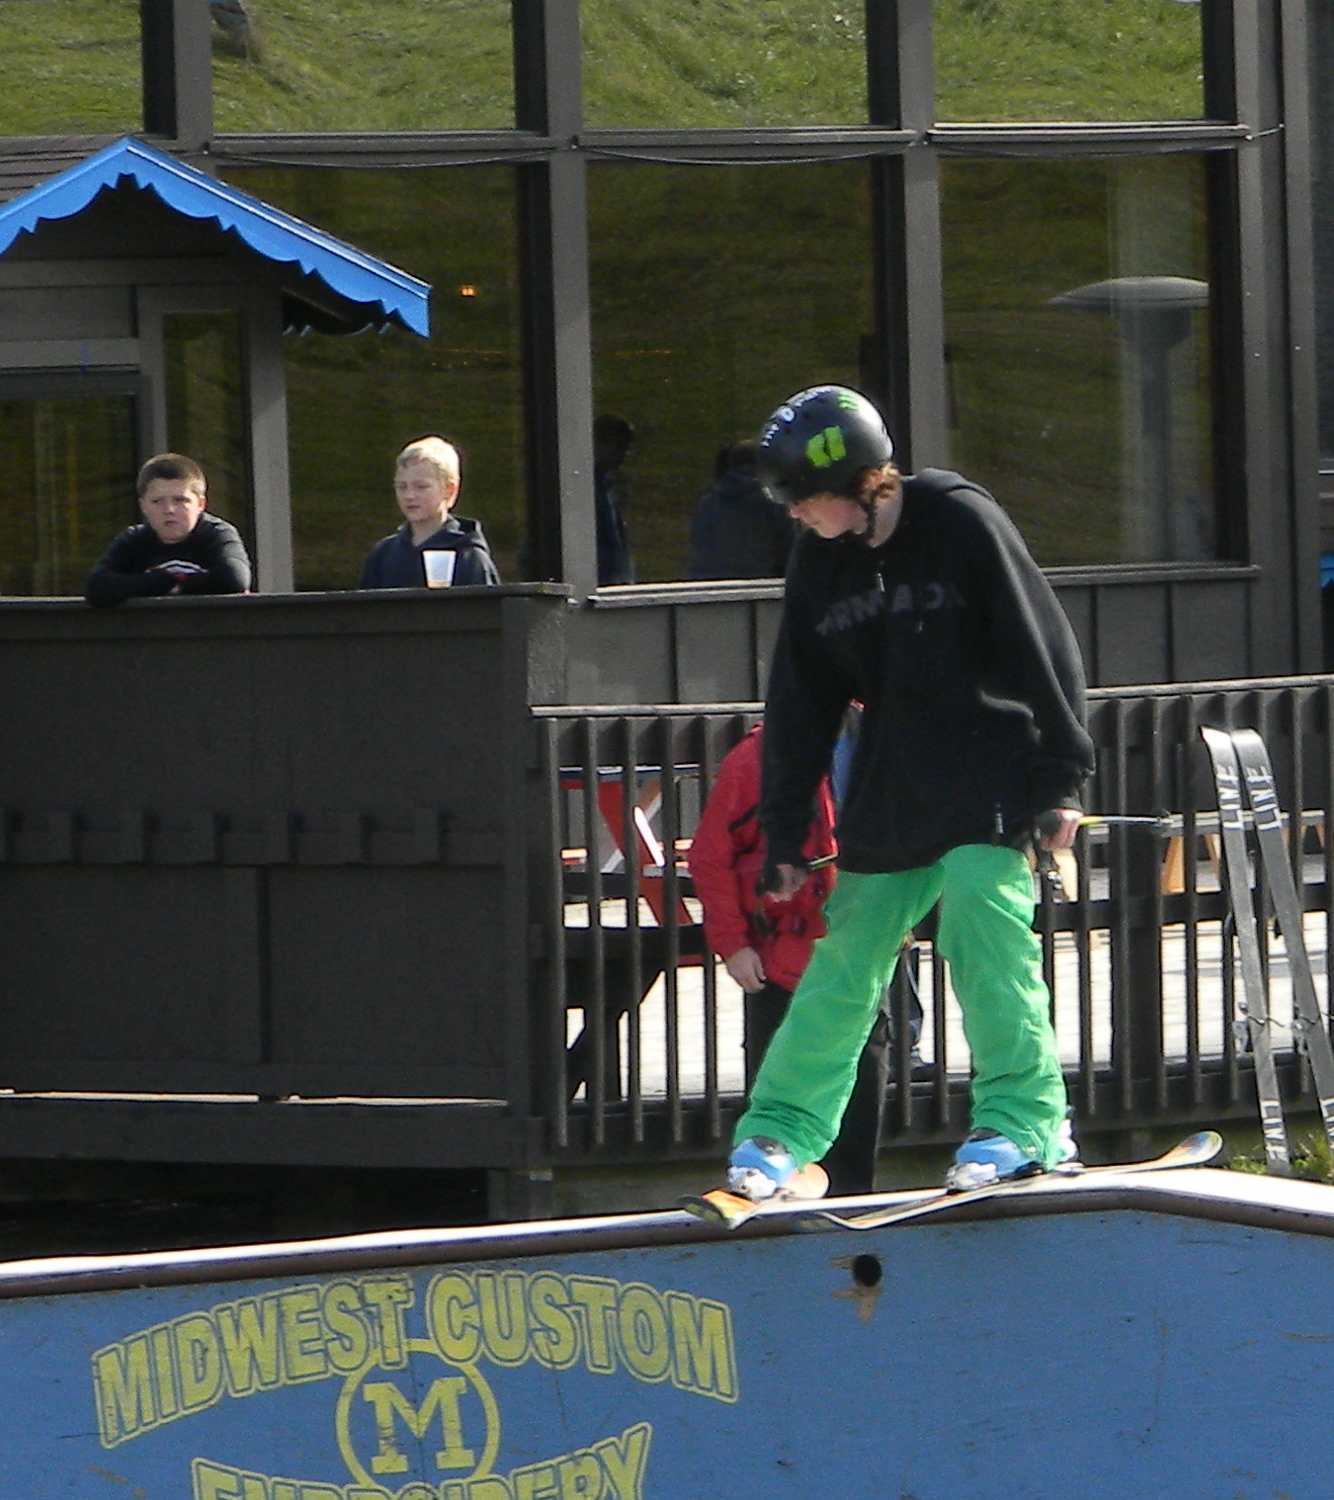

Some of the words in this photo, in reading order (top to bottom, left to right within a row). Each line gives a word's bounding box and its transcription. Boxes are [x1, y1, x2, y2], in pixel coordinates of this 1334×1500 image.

[1216, 764, 1244, 829] LINE
[1245, 765, 1283, 831] LINE
[1260, 1100, 1287, 1162] LINE
[91, 1273, 415, 1449] MIDWEST
[426, 1269, 740, 1404] CUSTOM
[362, 1376, 475, 1475] M
